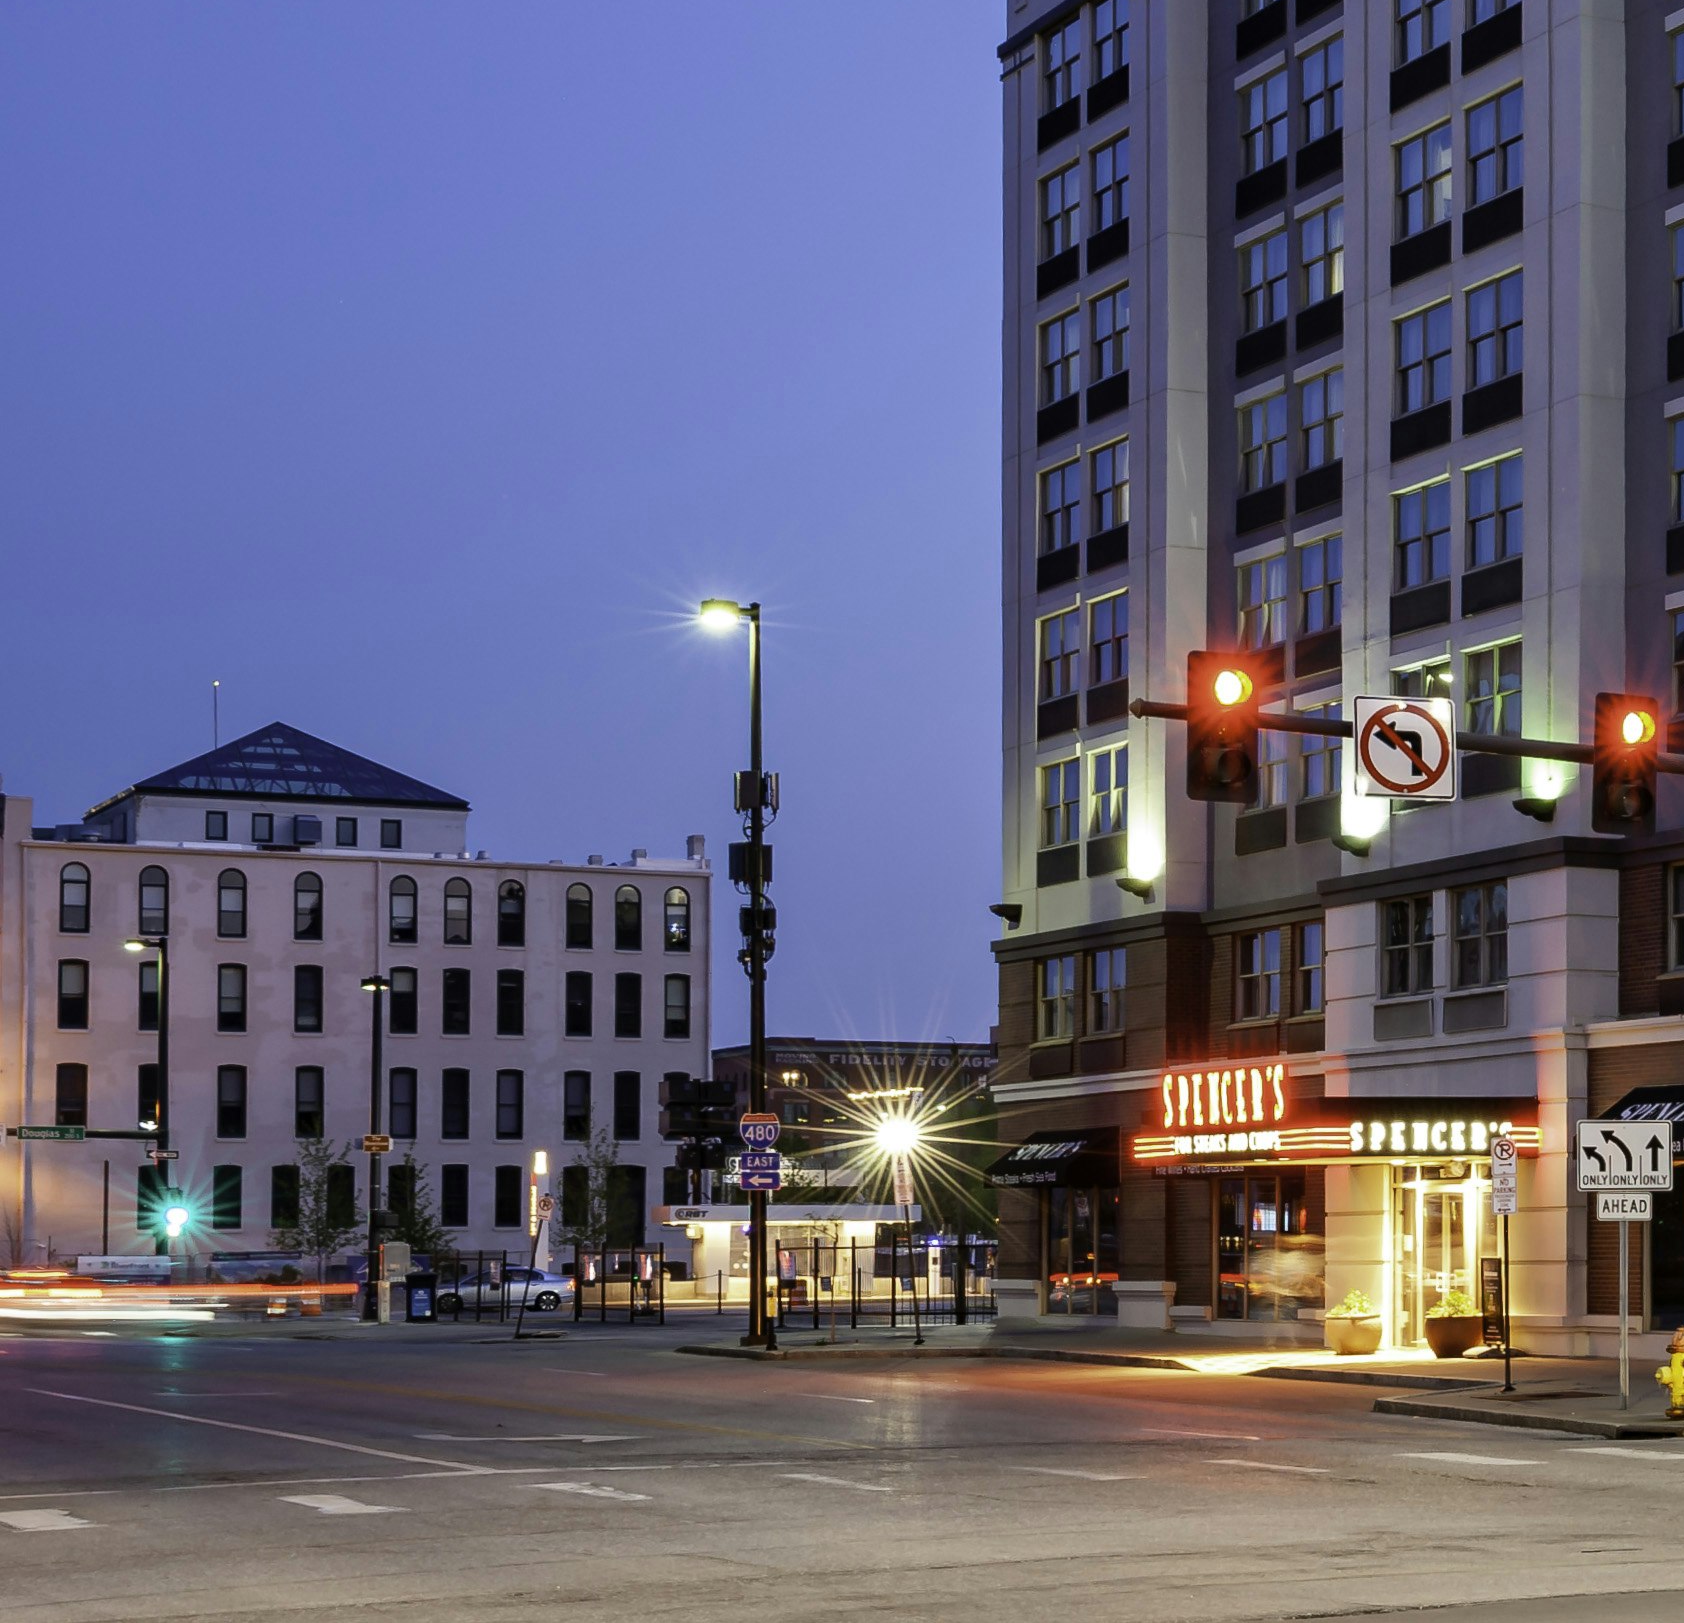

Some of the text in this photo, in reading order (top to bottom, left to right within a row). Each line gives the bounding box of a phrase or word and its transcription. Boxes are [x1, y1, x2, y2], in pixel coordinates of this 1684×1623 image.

[829, 1054, 992, 1068] FIDELITY STOAGE
[1162, 1064, 1285, 1128] SPENCER'S
[22, 1128, 60, 1139] Douglas
[745, 1125, 775, 1141] 480
[1672, 1141, 1681, 1152] ea
[747, 1157, 774, 1167] EAST
[1582, 1175, 1668, 1185] ONLY ONLY ONLY
[1602, 1199, 1647, 1213] AHEAD
